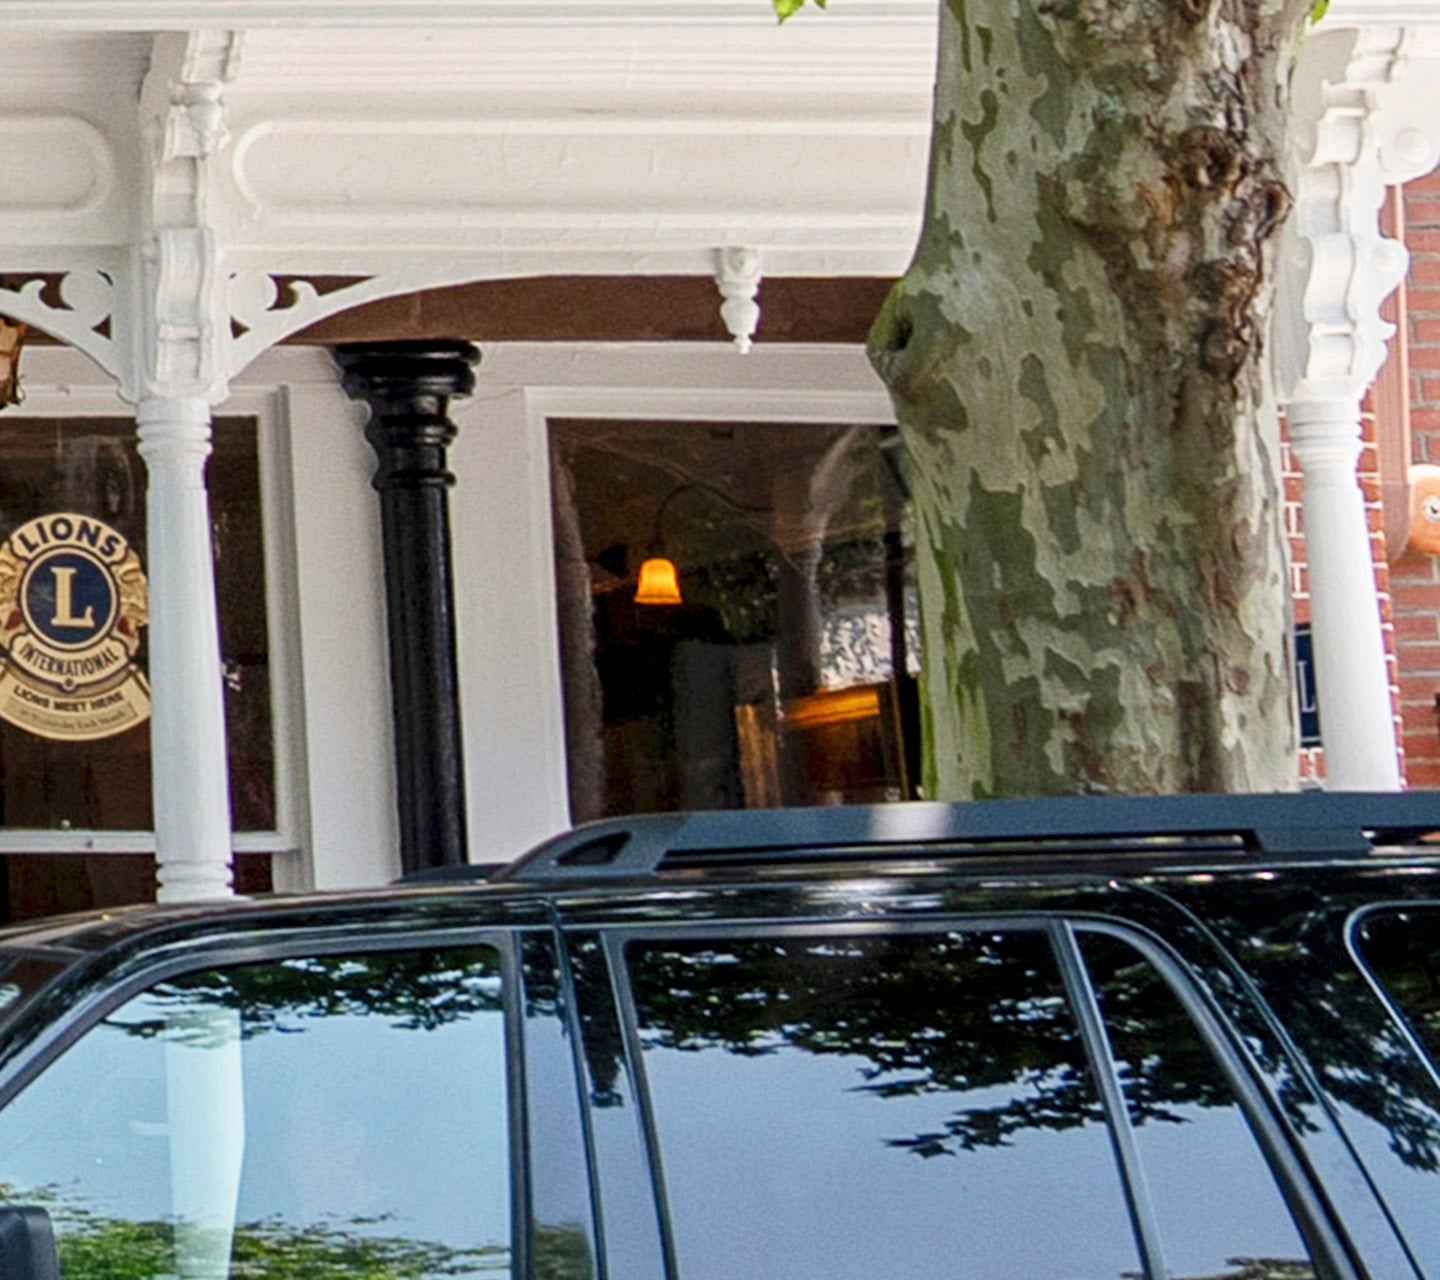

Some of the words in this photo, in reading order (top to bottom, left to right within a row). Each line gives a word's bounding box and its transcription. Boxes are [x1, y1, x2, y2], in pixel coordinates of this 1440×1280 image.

[17, 516, 122, 558] LIONS
[49, 566, 96, 628] L
[18, 643, 120, 678] INTERNATIONAL
